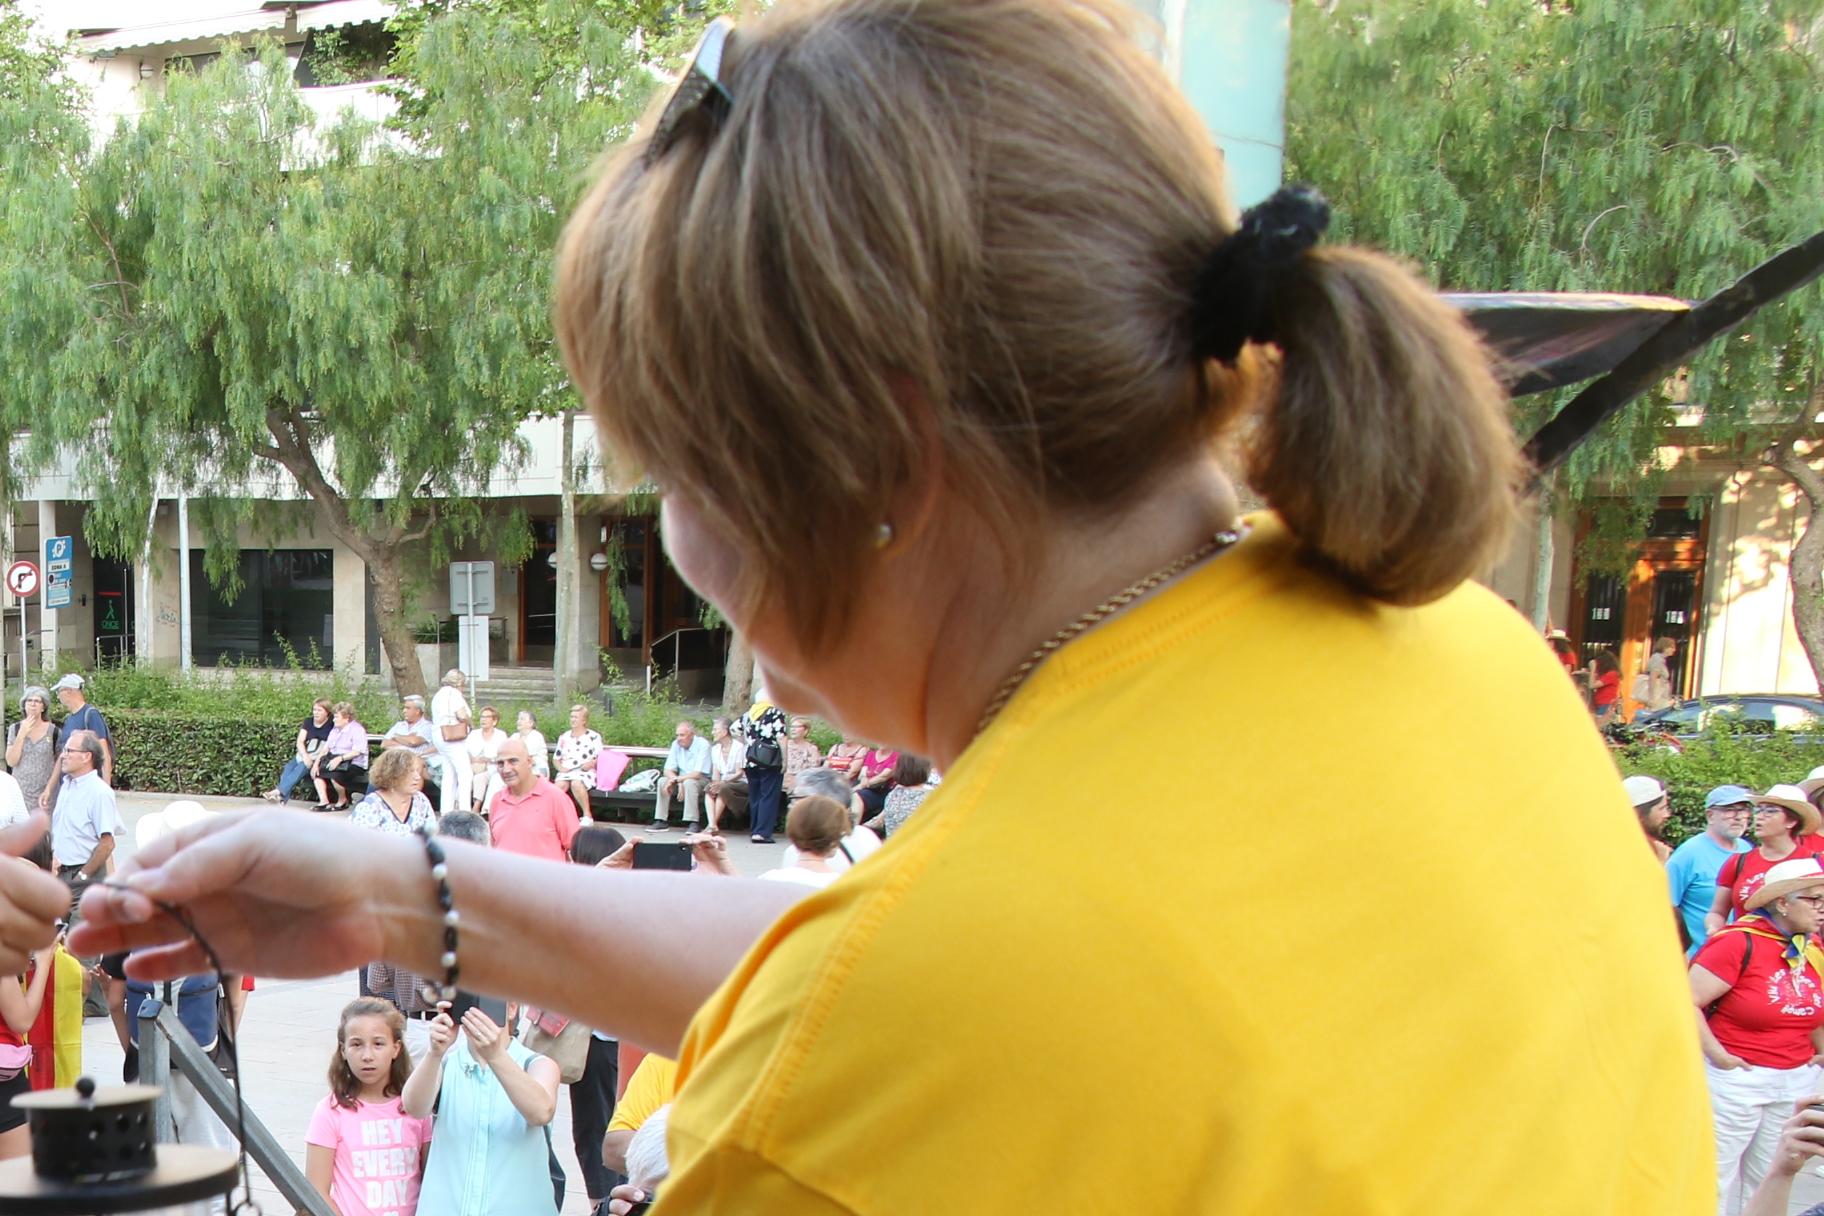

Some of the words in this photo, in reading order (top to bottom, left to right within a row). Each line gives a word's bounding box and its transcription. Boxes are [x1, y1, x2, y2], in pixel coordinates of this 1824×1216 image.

[360, 1118, 403, 1145] HEY
[351, 1147, 418, 1178] EVERY
[366, 1179, 408, 1208] DAY
